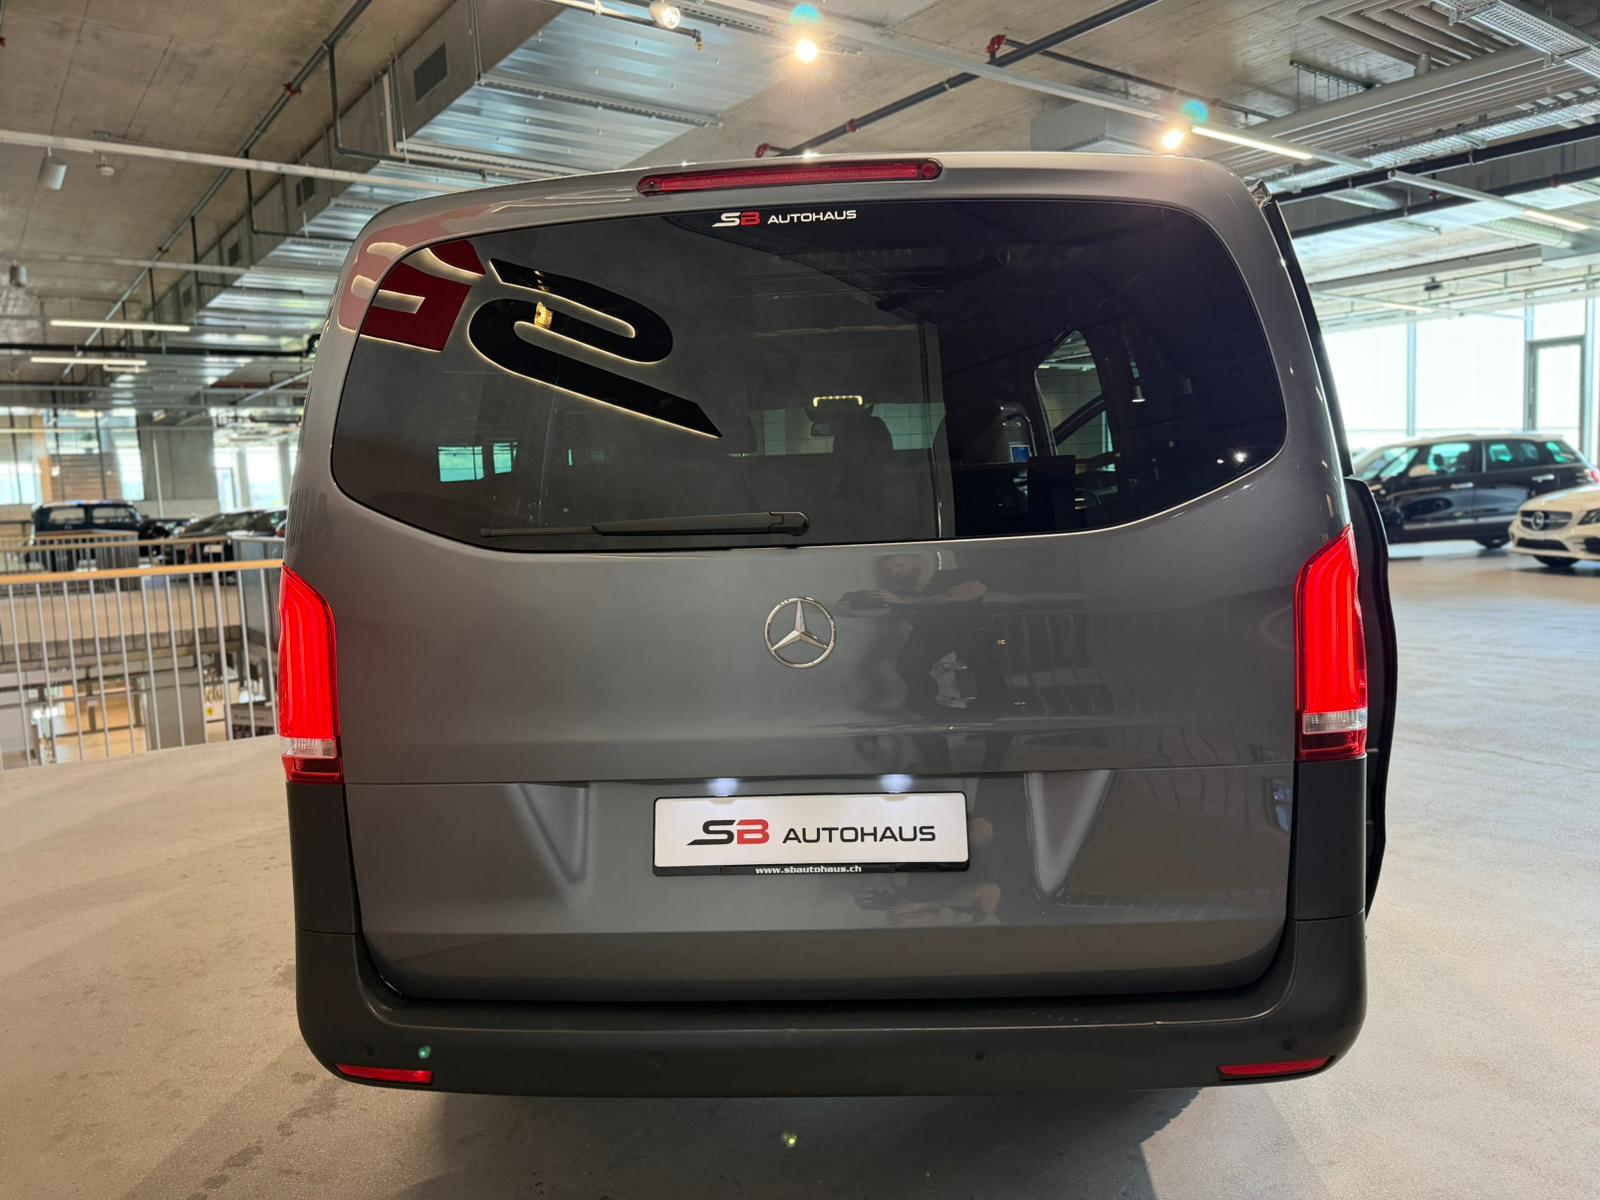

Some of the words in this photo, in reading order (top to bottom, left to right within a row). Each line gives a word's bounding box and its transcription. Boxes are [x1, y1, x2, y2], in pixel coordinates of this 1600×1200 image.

[711, 211, 761, 228] SB
[767, 210, 857, 225] AUTOHAUS
[686, 818, 769, 846] SB
[782, 825, 936, 844] AUTOHAUS
[755, 865, 862, 874] www.sbautohaus.ch
